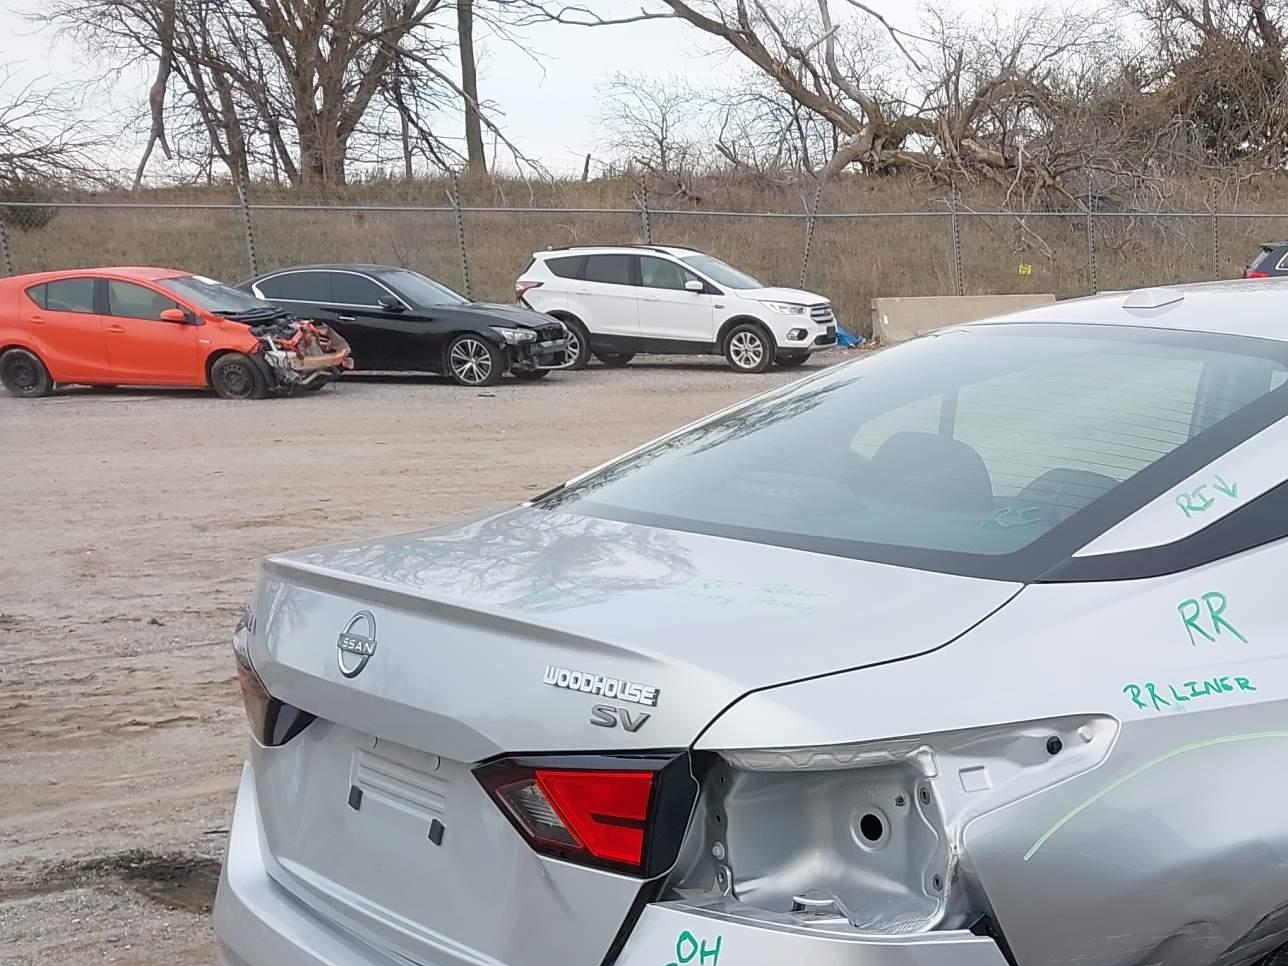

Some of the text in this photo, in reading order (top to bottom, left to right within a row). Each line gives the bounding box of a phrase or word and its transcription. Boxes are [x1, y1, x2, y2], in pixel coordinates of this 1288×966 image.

[1176, 590, 1249, 647] RR
[543, 665, 661, 707] WOODHOUSE
[1173, 675, 1257, 703] LINER
[589, 704, 651, 733] SV
